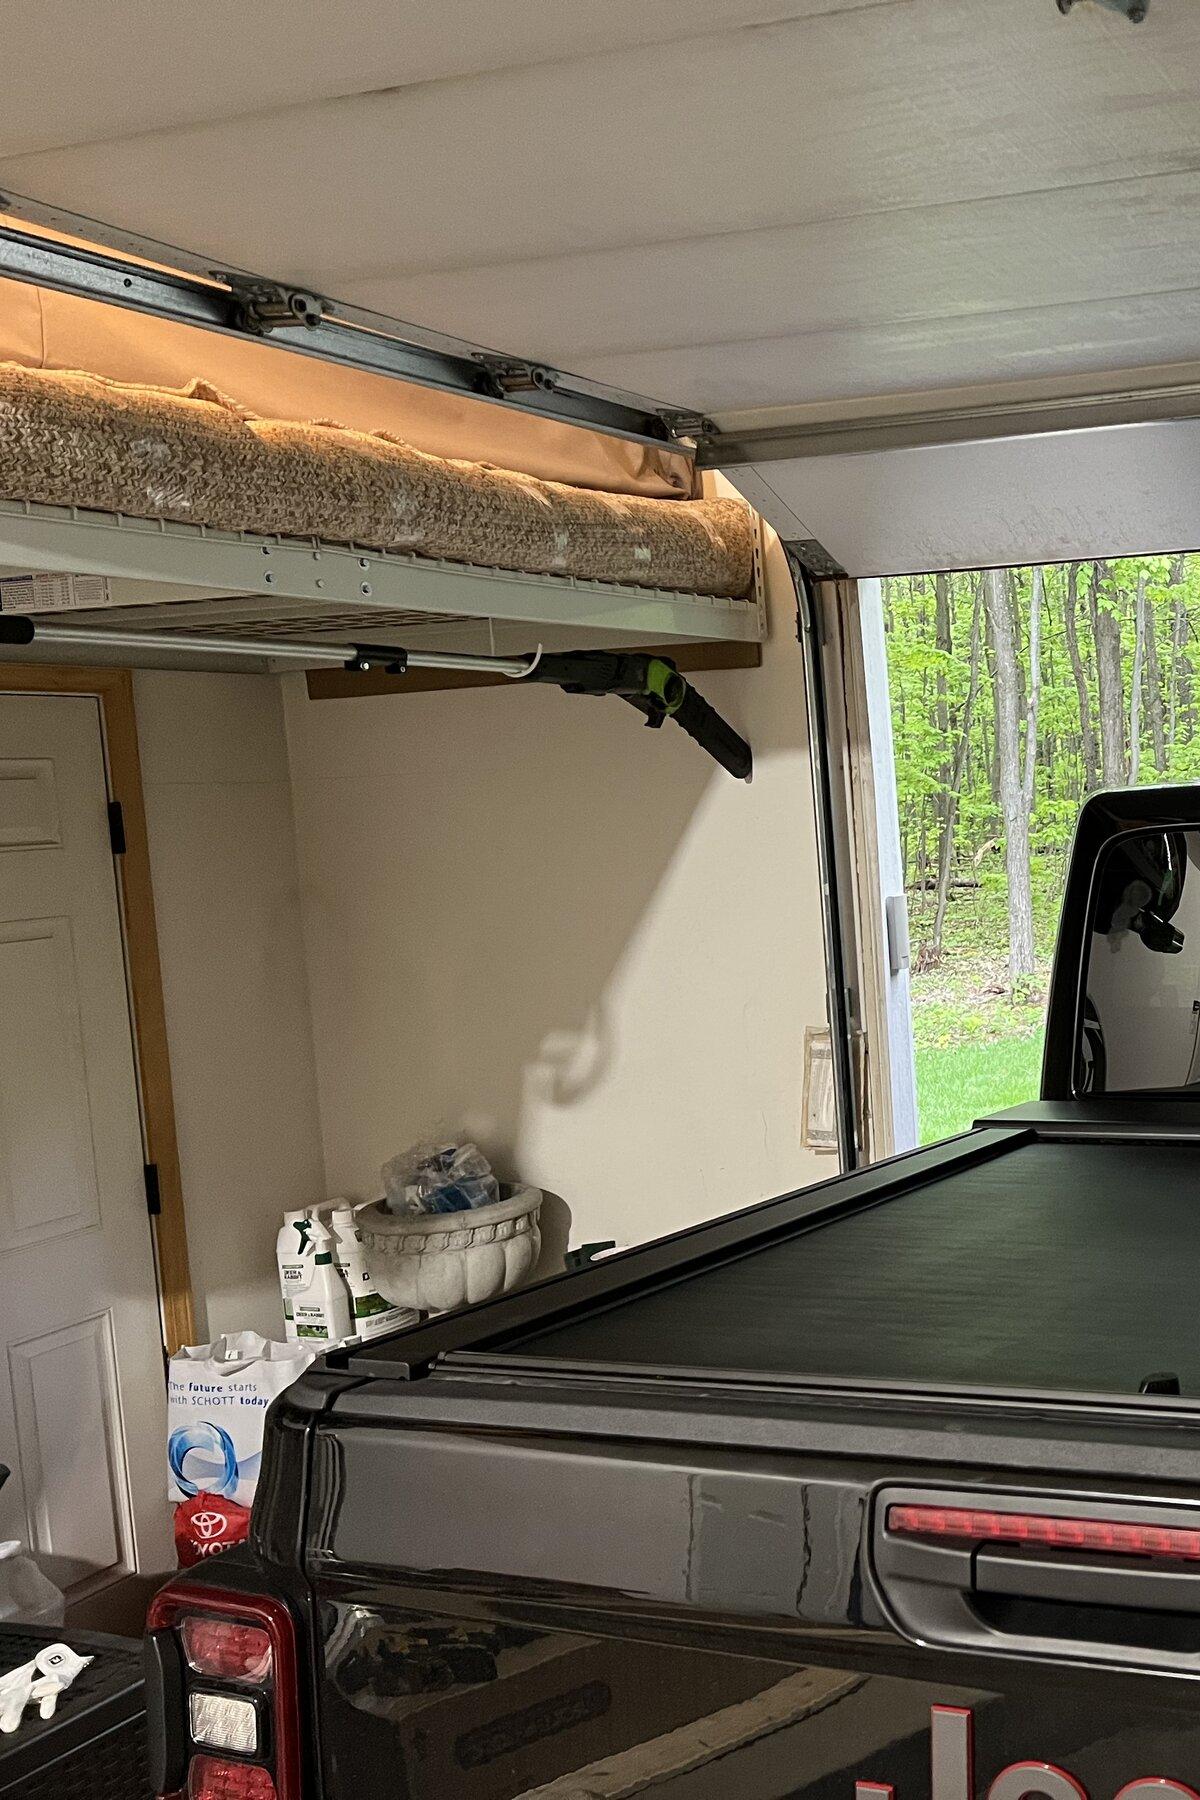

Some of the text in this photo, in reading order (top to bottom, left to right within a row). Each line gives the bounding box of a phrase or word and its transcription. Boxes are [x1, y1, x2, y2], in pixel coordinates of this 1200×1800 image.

[169, 1381, 257, 1393] The future starts
[192, 1395, 235, 1406] SCHOTT
[240, 1396, 269, 1409] today
